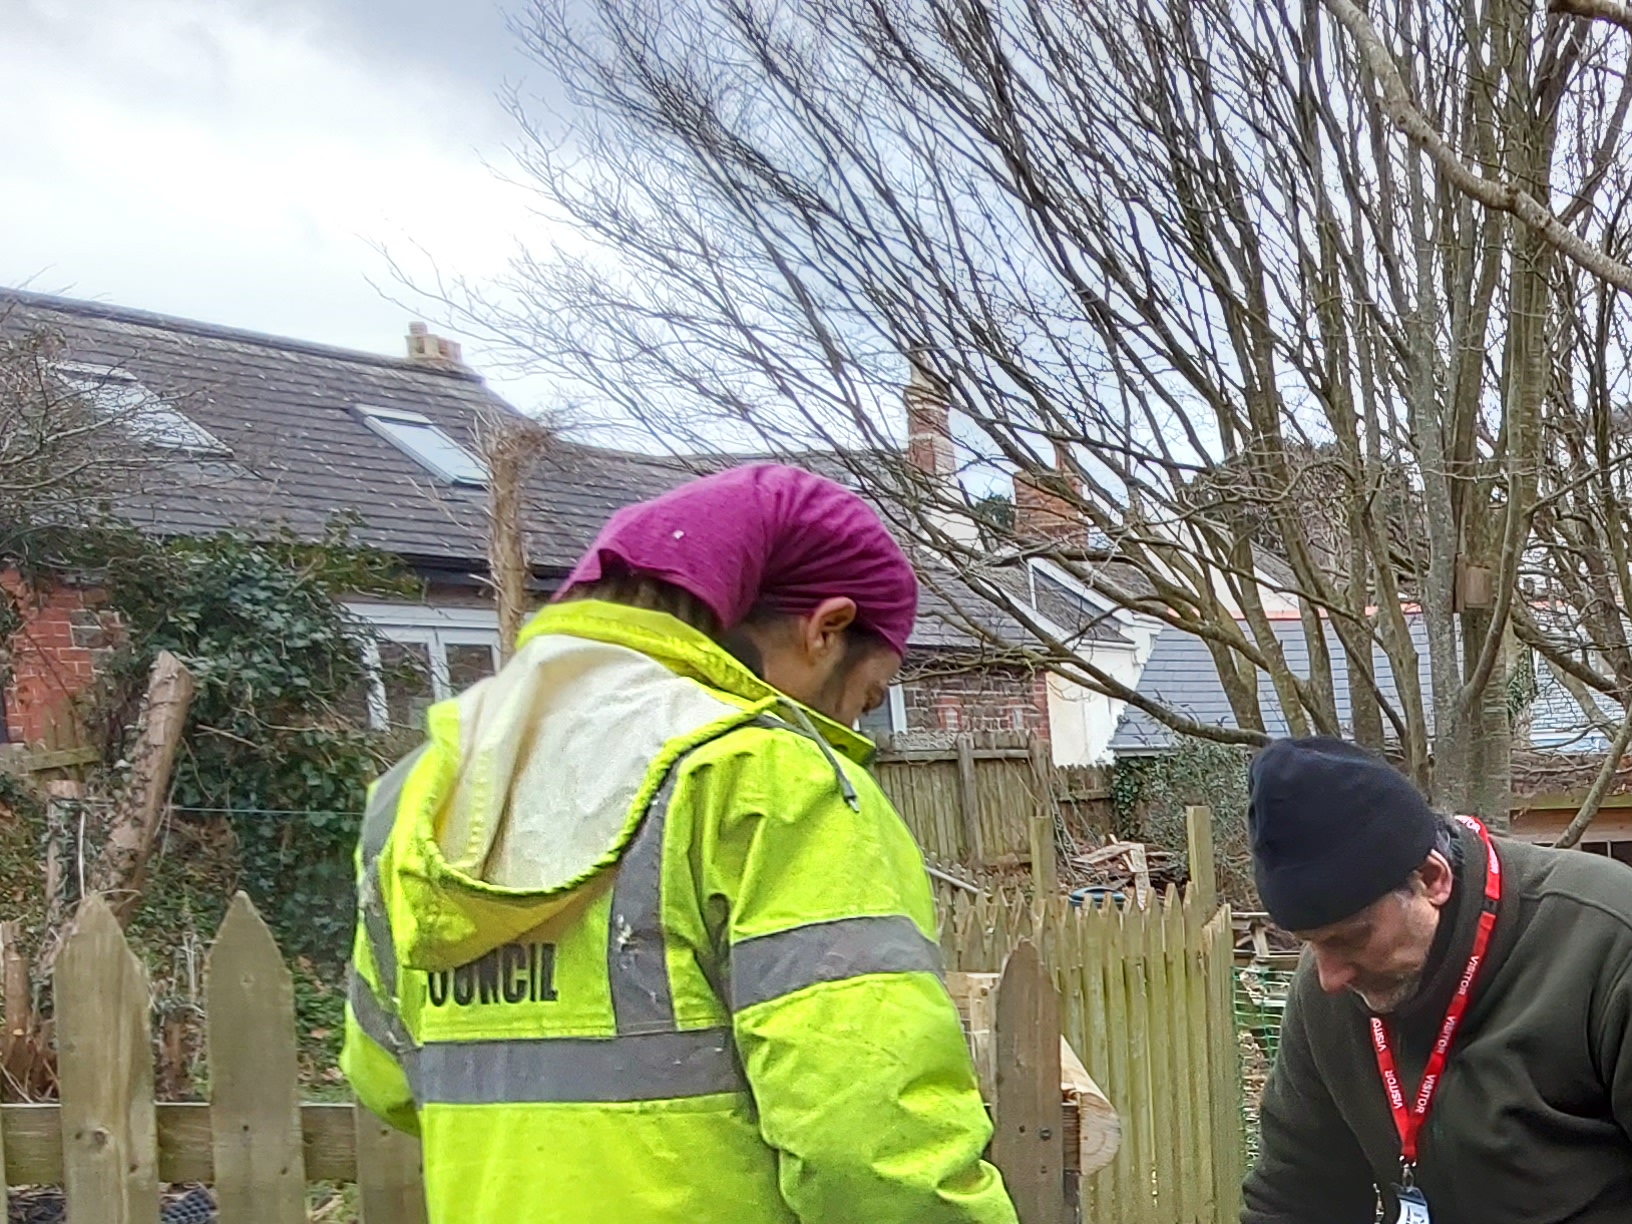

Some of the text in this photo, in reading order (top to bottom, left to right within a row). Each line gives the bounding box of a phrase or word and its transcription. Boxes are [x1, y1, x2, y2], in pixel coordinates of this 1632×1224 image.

[427, 943, 557, 1008] OUNCIL
[1458, 955, 1480, 995] VISITOR
[1436, 1015, 1457, 1054] VISITOR
[1384, 1069, 1403, 1109] VISITOR
[1414, 1074, 1437, 1113] VISITOR
